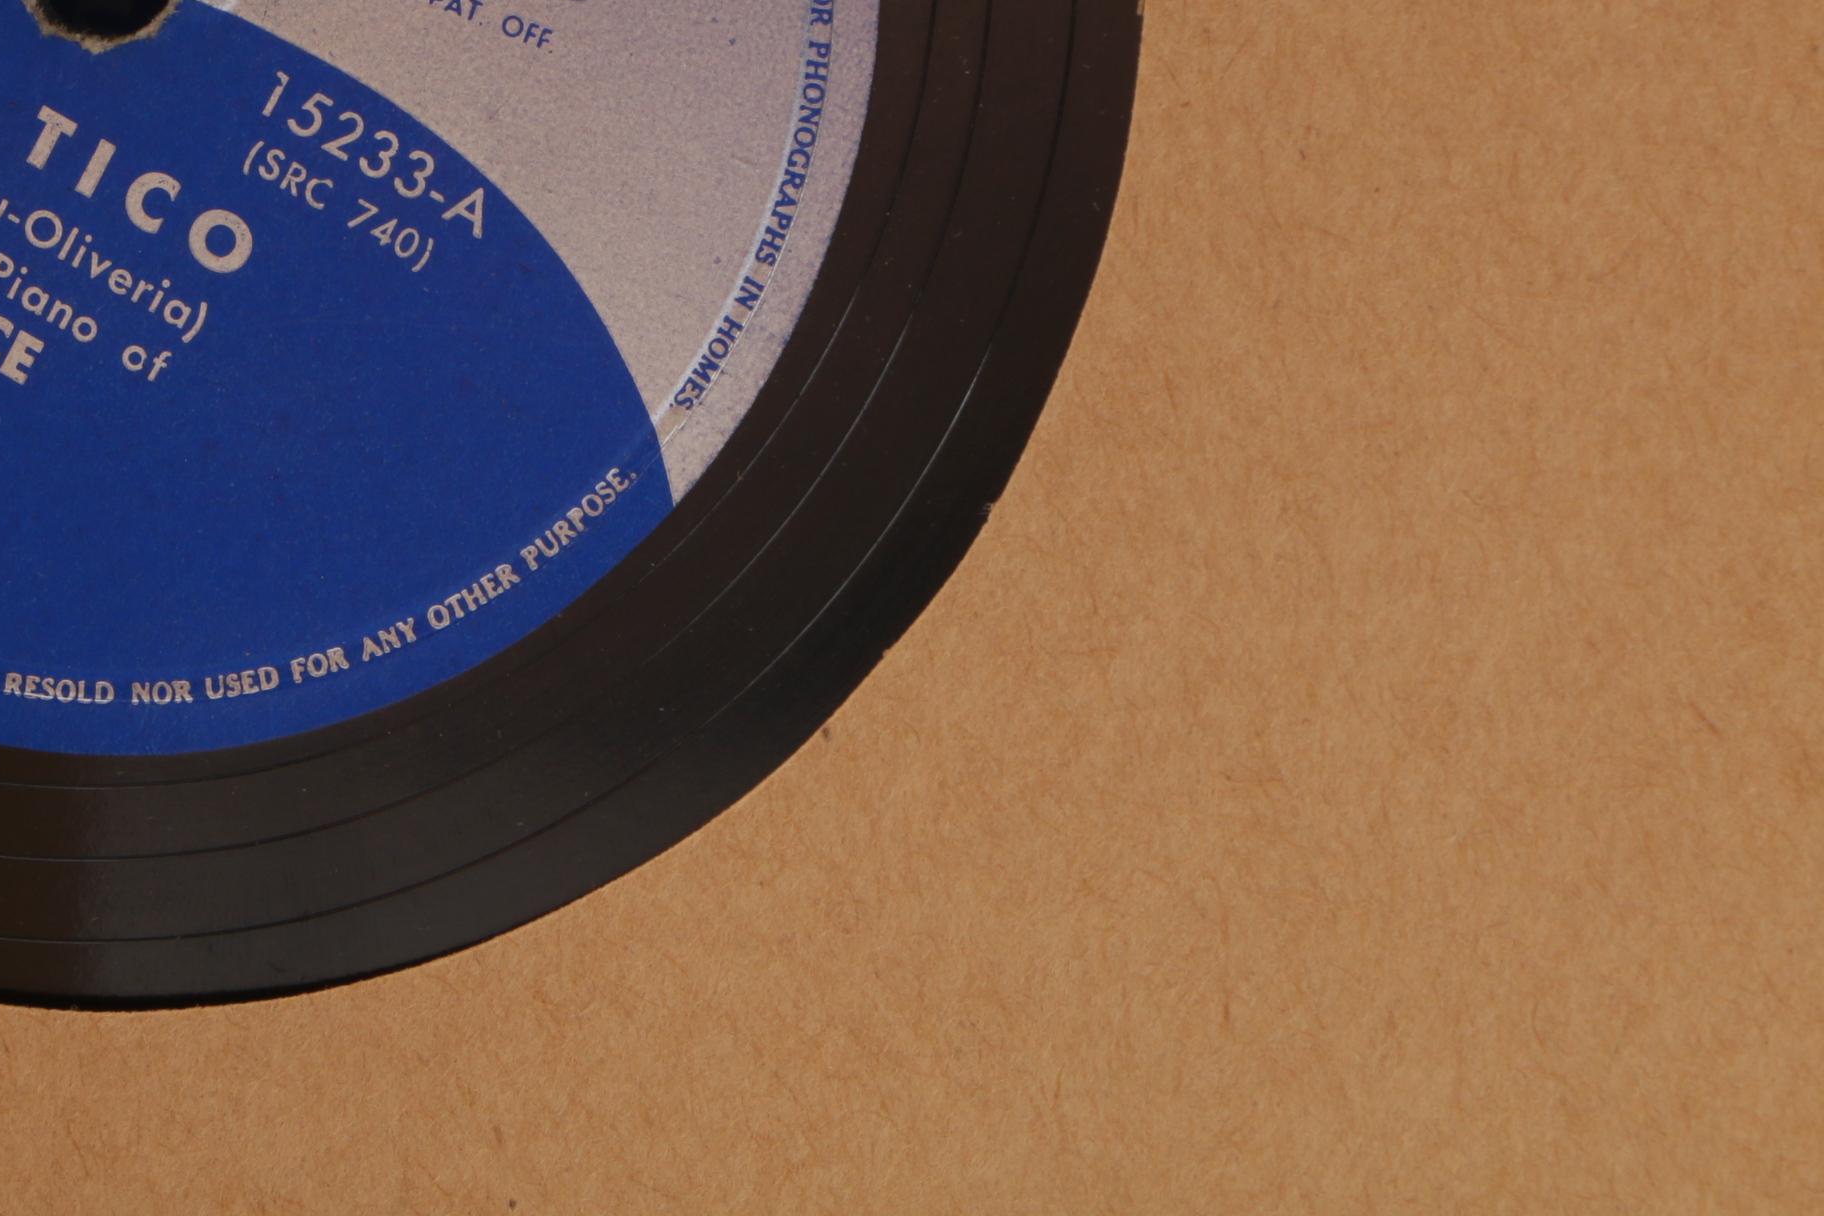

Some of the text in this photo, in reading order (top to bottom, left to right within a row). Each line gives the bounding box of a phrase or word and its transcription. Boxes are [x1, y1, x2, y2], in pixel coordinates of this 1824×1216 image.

[25, 105, 254, 274] TICO
[242, 140, 435, 273] (SRC 740)
[261, 71, 488, 239] 15233-A
[754, 40, 832, 267] PHONOGRAPHS
[121, 343, 173, 383] of
[734, 275, 766, 312] IN
[2, 670, 115, 705] RESOLD
[130, 680, 194, 706] NOR
[205, 666, 280, 701] USED
[290, 646, 351, 684] FOR
[362, 619, 419, 662] ANY
[427, 563, 521, 631] OTHER
